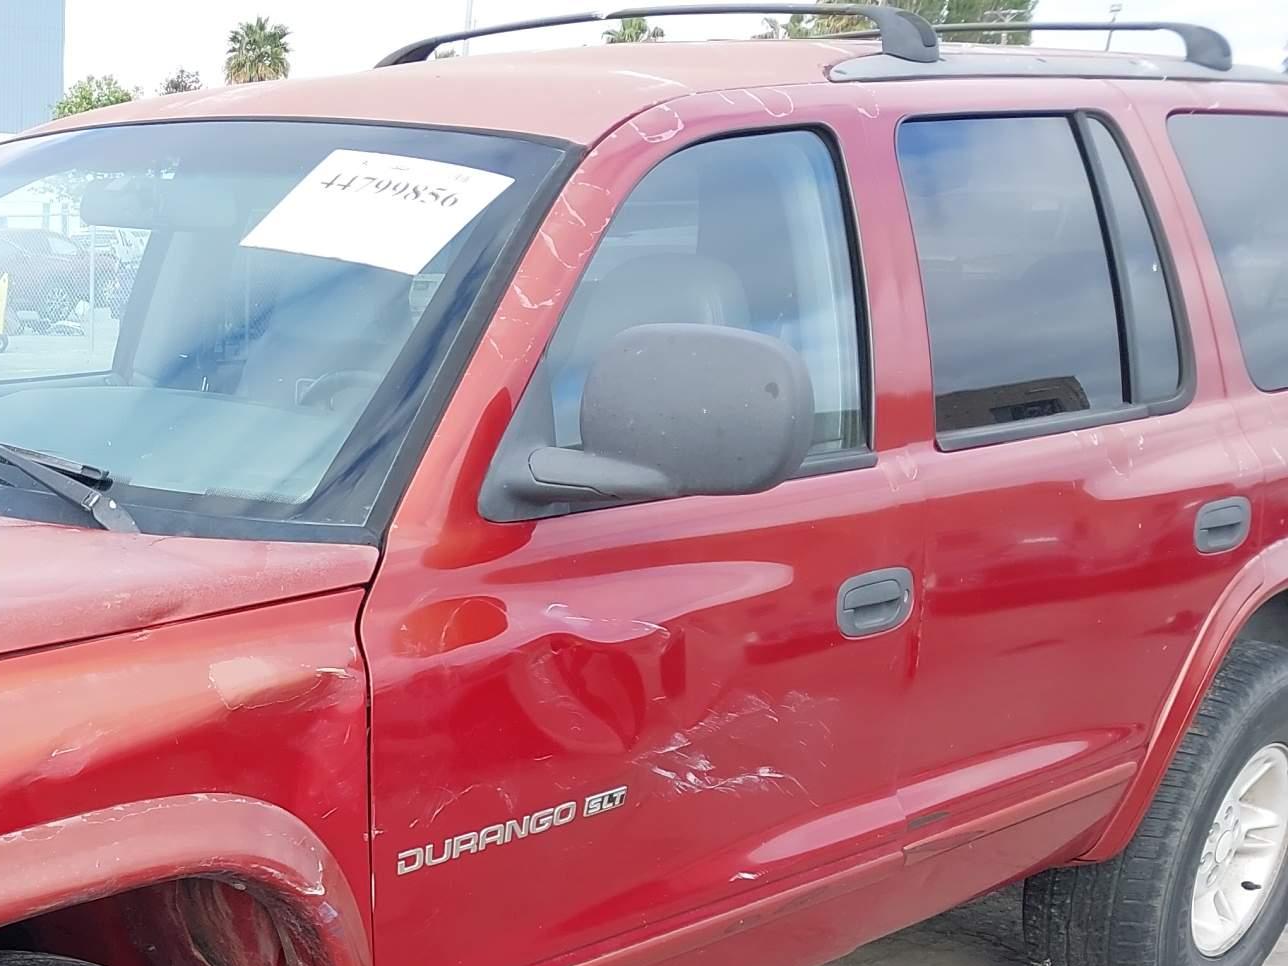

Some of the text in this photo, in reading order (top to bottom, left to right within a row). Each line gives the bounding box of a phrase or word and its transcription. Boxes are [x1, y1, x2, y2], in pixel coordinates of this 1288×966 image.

[321, 172, 459, 207] 44799856
[396, 786, 627, 876] DURANGO SLT
